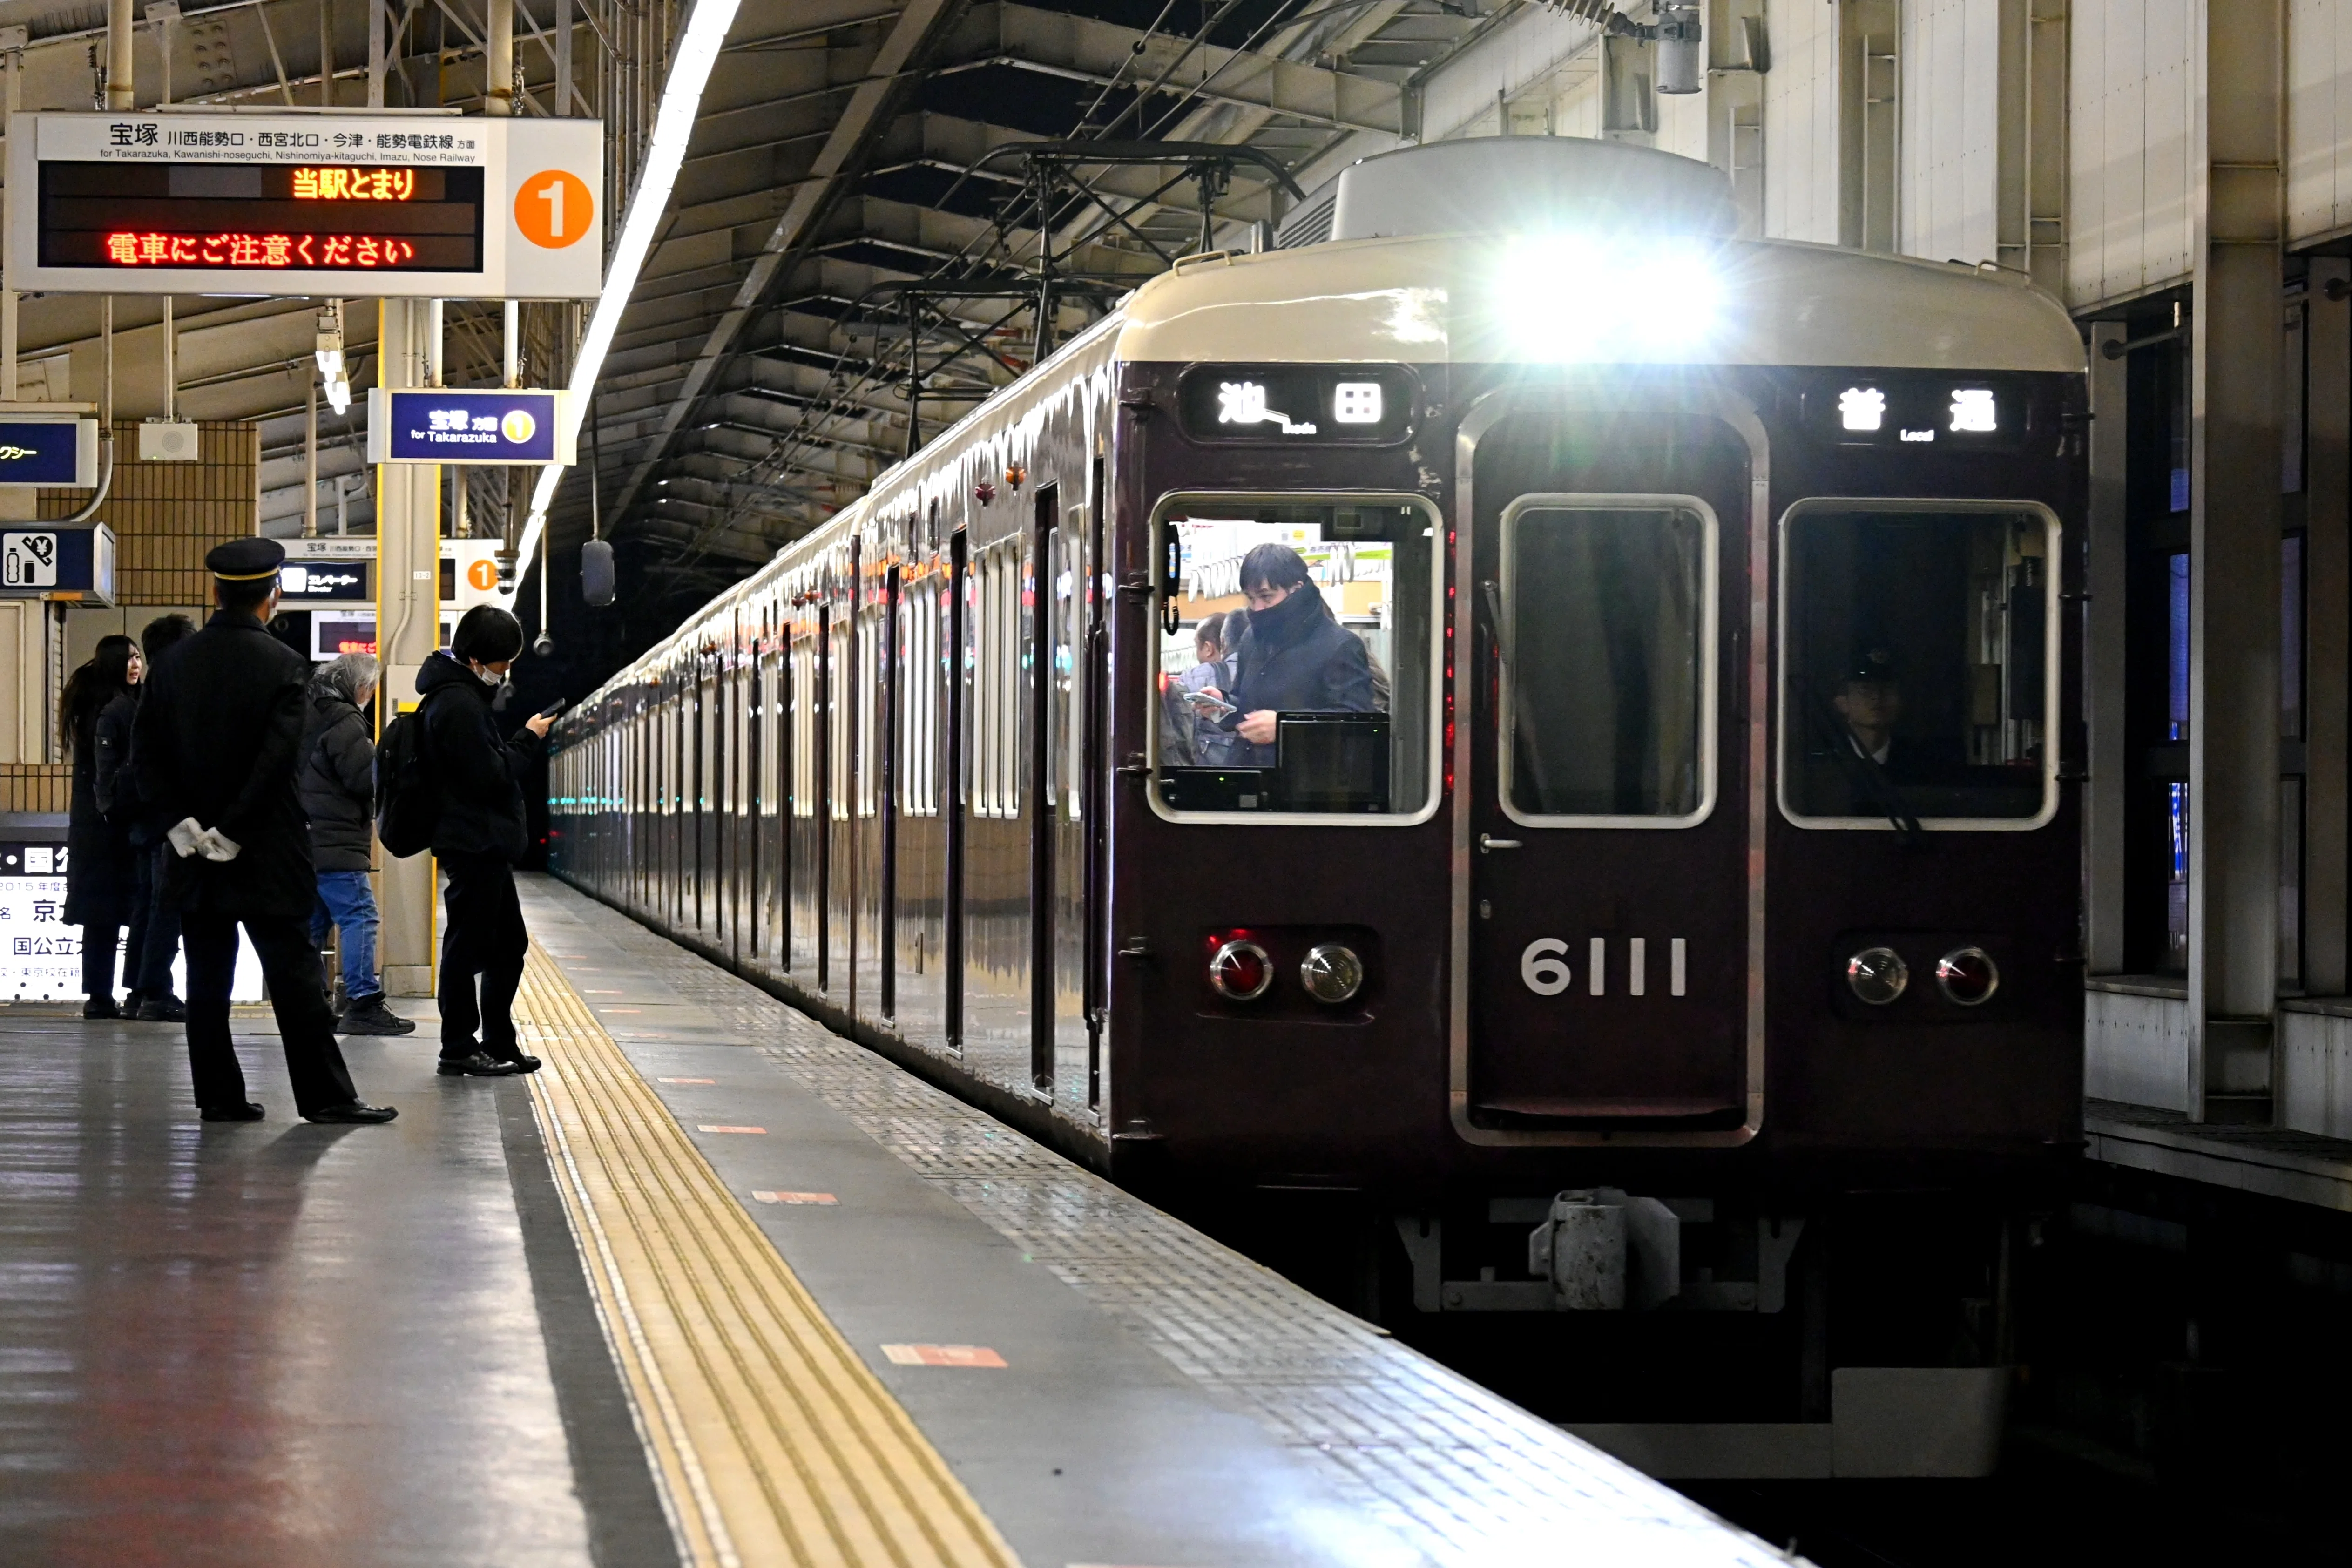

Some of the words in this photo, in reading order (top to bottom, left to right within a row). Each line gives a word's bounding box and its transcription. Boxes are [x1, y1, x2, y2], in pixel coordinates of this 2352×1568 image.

[110, 123, 158, 146] 宝塚
[168, 131, 453, 149] 川西能勢口・西宮北口・今津・能勢電鉄線
[457, 140, 475, 149] 方面
[115, 149, 171, 159] Takarazuka,
[175, 150, 273, 161] Kawanishi-noseguchi,
[276, 151, 377, 162] Nishinomiya-kitaguchi,
[380, 153, 410, 162] Imazu,
[413, 153, 437, 162] Nose
[440, 153, 475, 163] Railway
[293, 169, 412, 199] 当駅とまり
[538, 181, 564, 237] 1
[107, 233, 413, 266] 電車にご注意ください
[411, 429, 426, 439] for
[427, 431, 497, 443] Takarazuka
[510, 416, 524, 439] 1
[477, 564, 488, 587] 1
[1521, 937, 1686, 996] 6111
